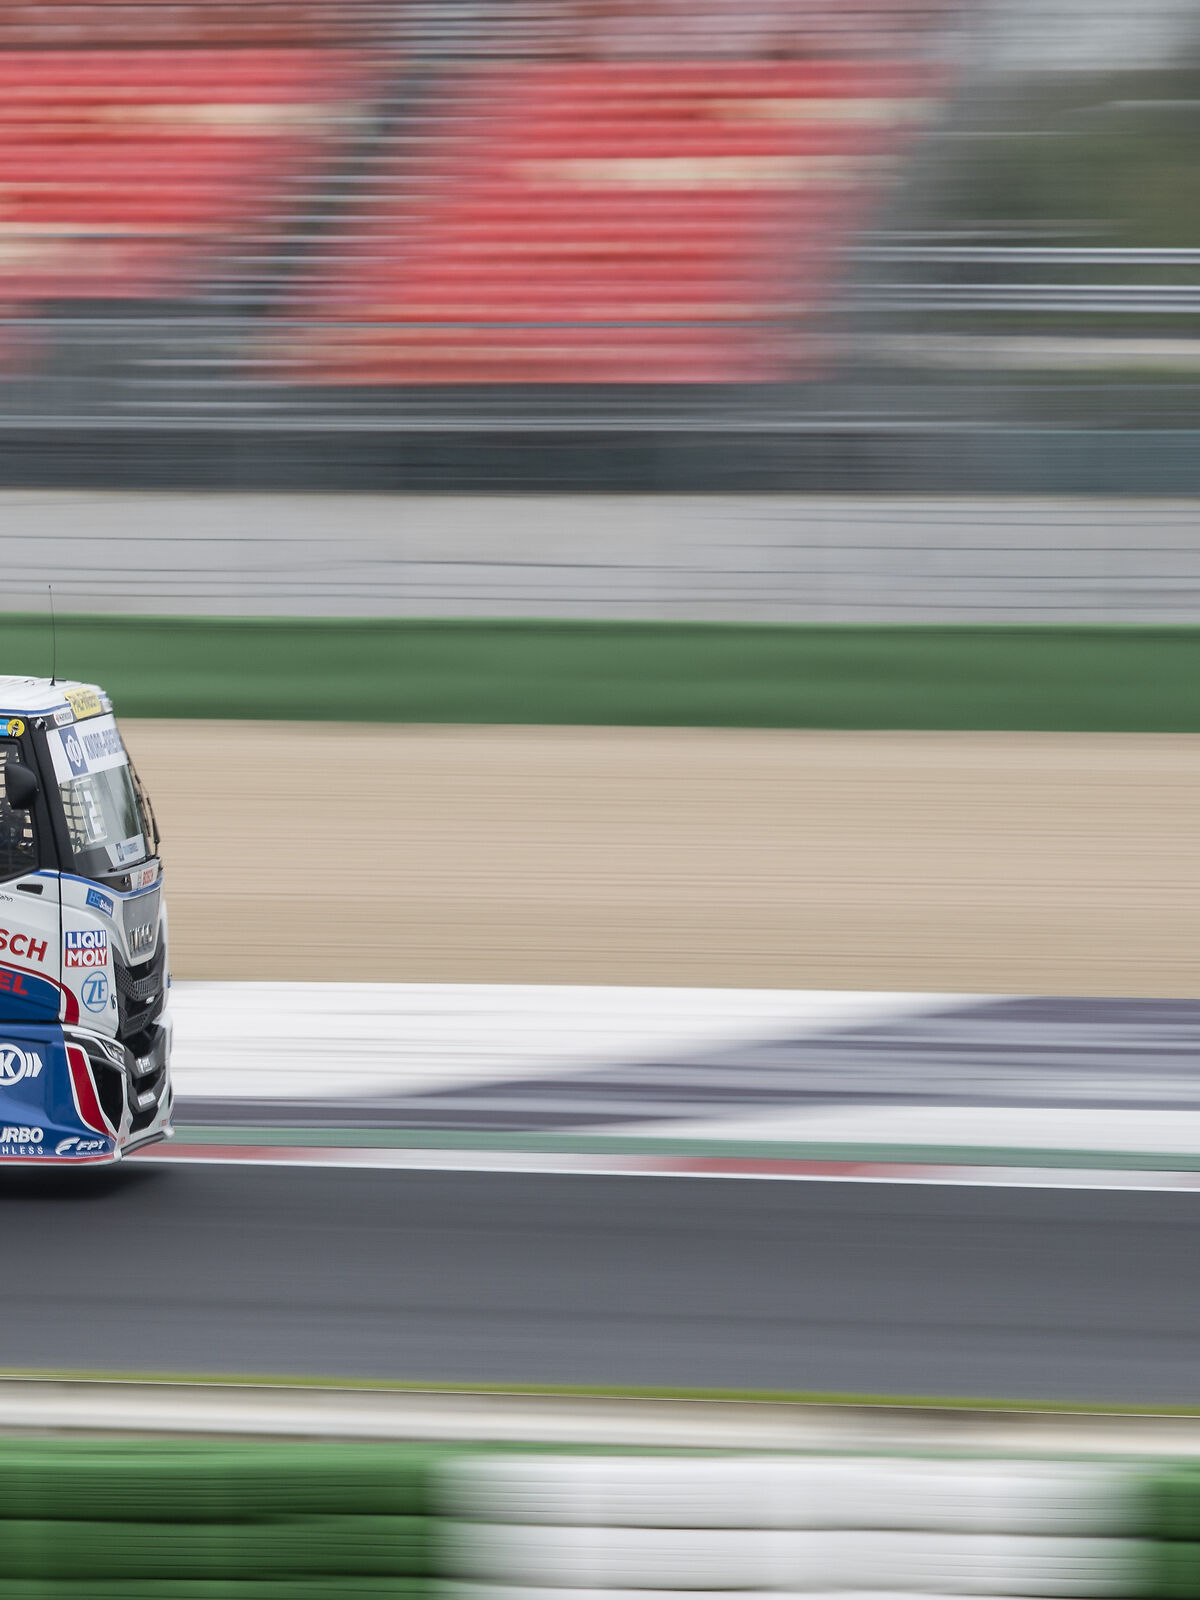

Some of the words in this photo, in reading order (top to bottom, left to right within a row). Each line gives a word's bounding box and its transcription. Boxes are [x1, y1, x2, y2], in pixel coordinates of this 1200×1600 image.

[67, 931, 106, 949] LIQUI
[67, 950, 107, 967] MOLY
[76, 1139, 106, 1151] FPT
